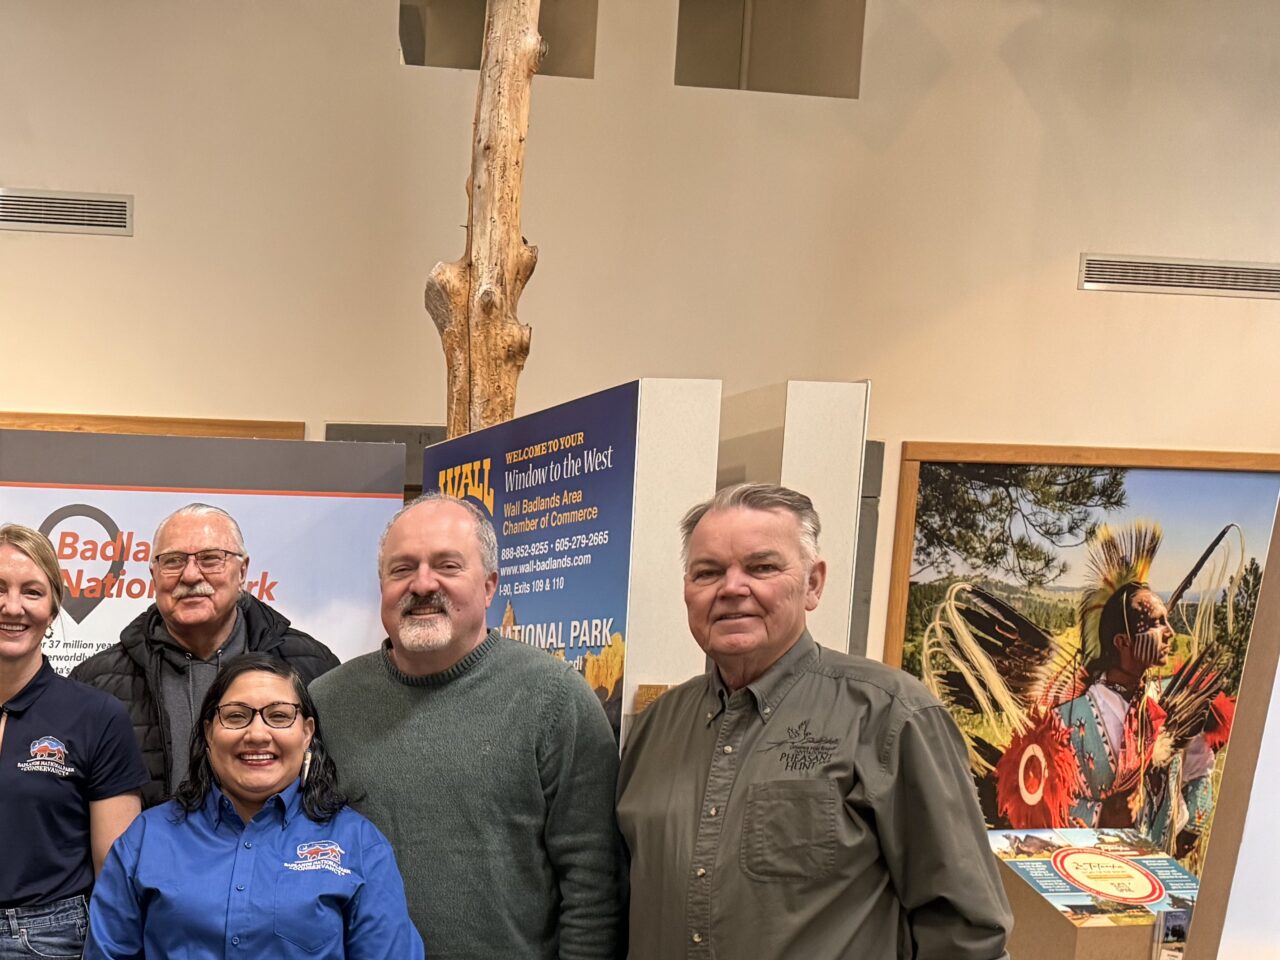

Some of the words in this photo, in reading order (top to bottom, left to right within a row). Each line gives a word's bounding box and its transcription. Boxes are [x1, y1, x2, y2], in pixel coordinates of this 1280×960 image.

[505, 443, 547, 464] WELCOME
[548, 438, 559, 453] TO
[559, 431, 584, 450] YOUR
[505, 463, 548, 493] Window
[549, 460, 561, 482] to
[563, 453, 581, 479] the
[584, 445, 614, 474] West
[438, 457, 495, 517] WALL
[503, 501, 520, 518] Wall
[522, 492, 561, 514] Badlands
[562, 489, 583, 505] Area
[503, 517, 538, 535] Chamber
[540, 512, 550, 528] of
[550, 506, 598, 527] Commerce
[57, 531, 151, 562] Badla
[501, 541, 549, 560] 888-852-9255
[555, 530, 609, 552] 605-279-2665
[500, 554, 592, 576] www.wall-badlands.com
[60, 569, 156, 599] Natio
[247, 571, 279, 601] rk
[499, 584, 512, 597] I-90,
[514, 581, 530, 594] Exits
[532, 579, 544, 592] 109
[545, 578, 550, 591] &
[552, 577, 564, 590] 110
[48, 640, 61, 649] 37
[62, 640, 94, 649] million
[569, 617, 614, 648] PARK
